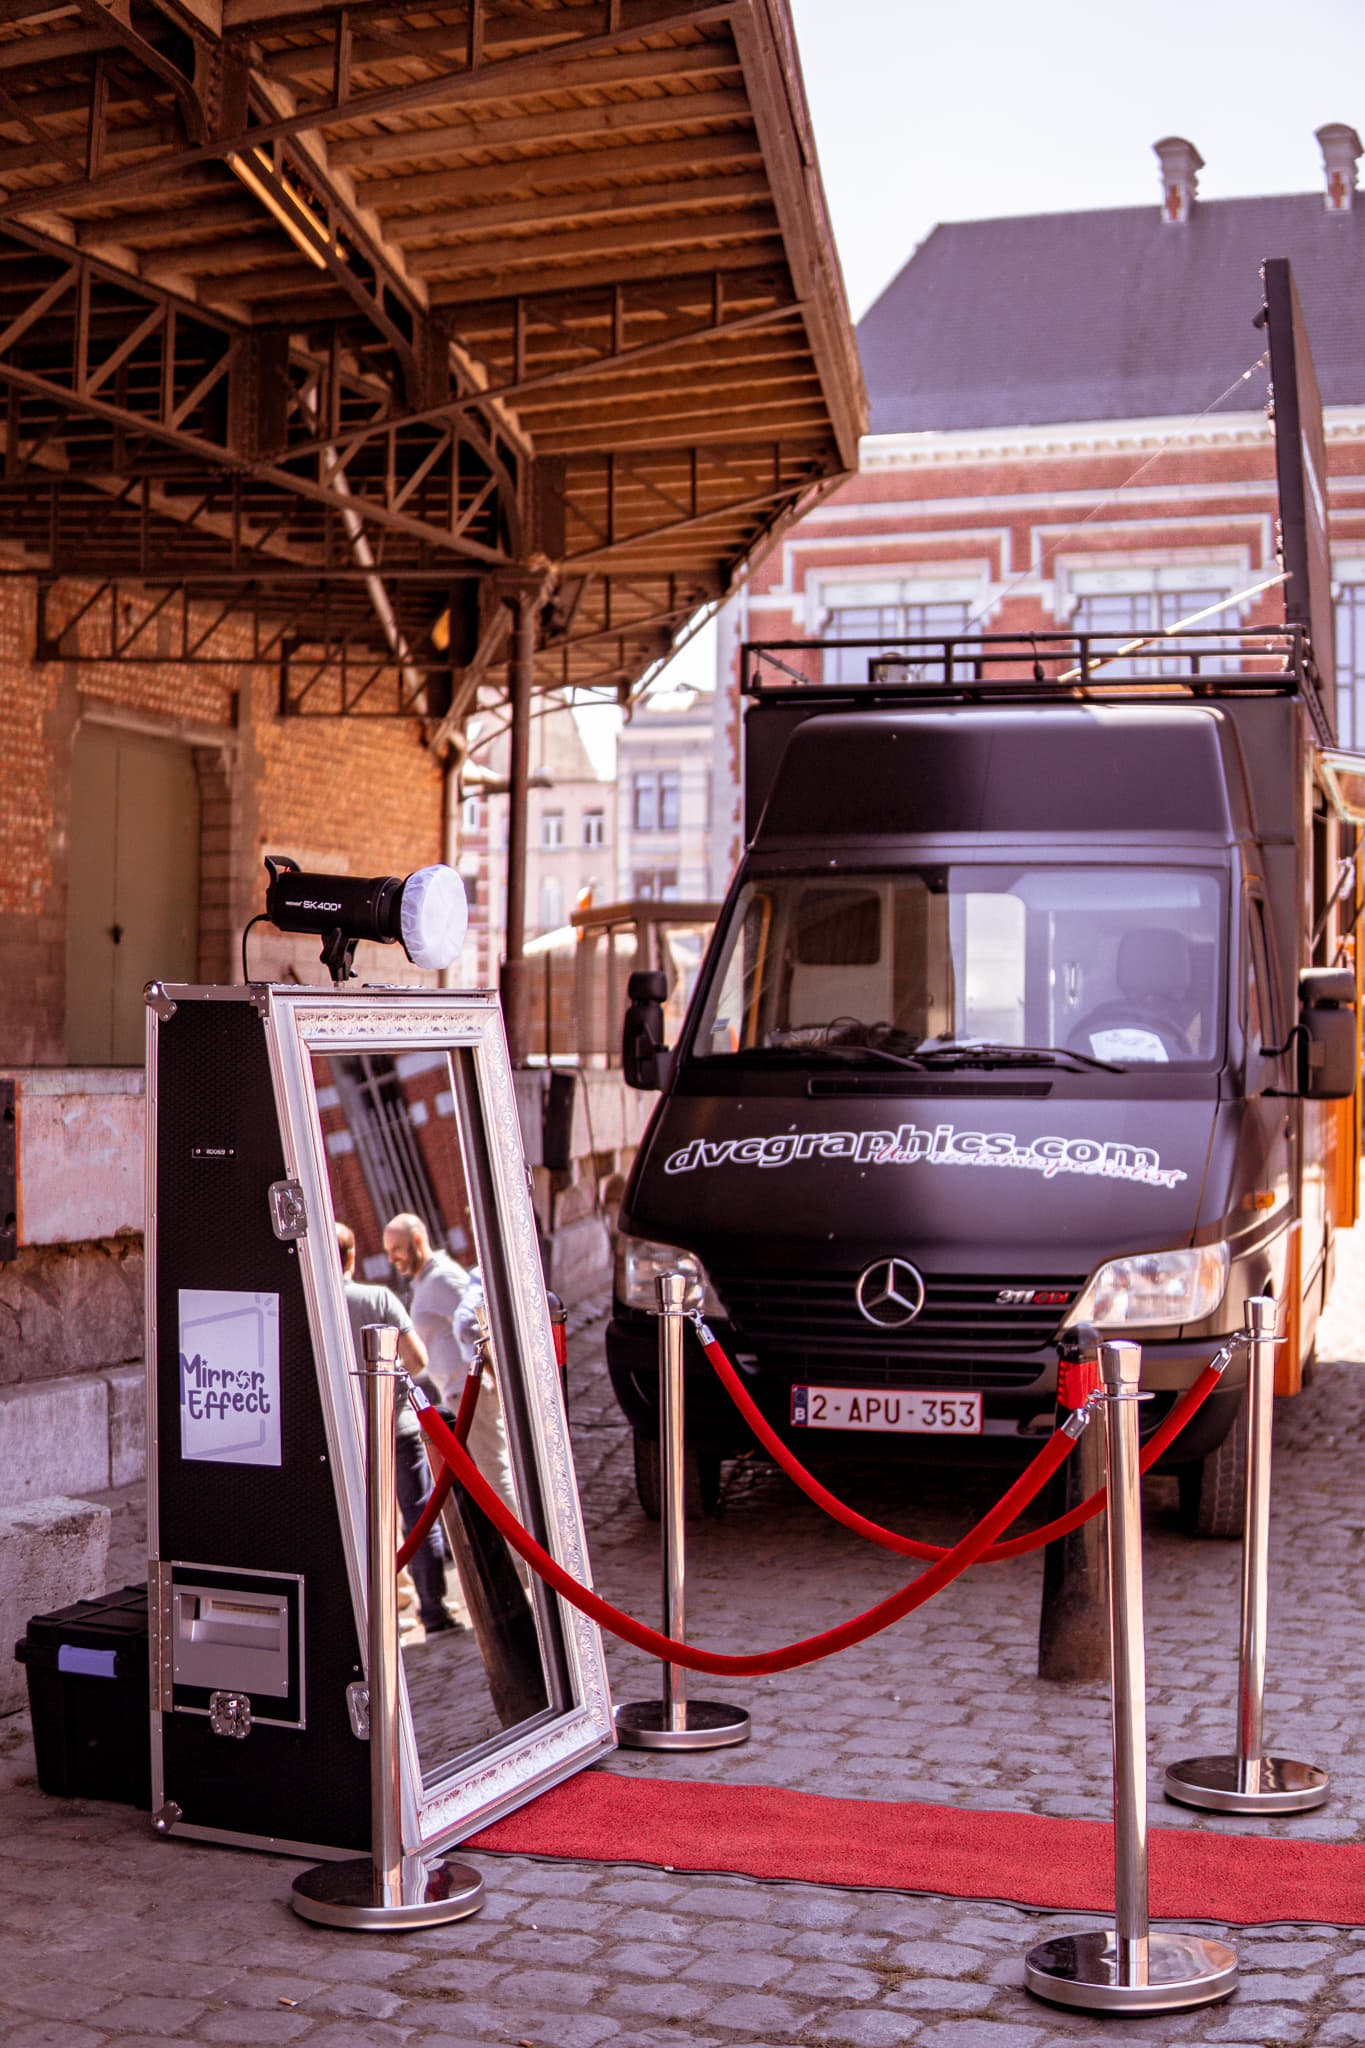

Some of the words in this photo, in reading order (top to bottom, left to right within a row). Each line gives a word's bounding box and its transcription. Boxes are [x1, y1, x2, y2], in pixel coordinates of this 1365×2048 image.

[664, 1124, 1160, 1175] dvcgraphics.com
[179, 1352, 266, 1405] Mirror
[187, 1386, 271, 1420] Effect
[811, 1394, 976, 1427] 2-APU-353
